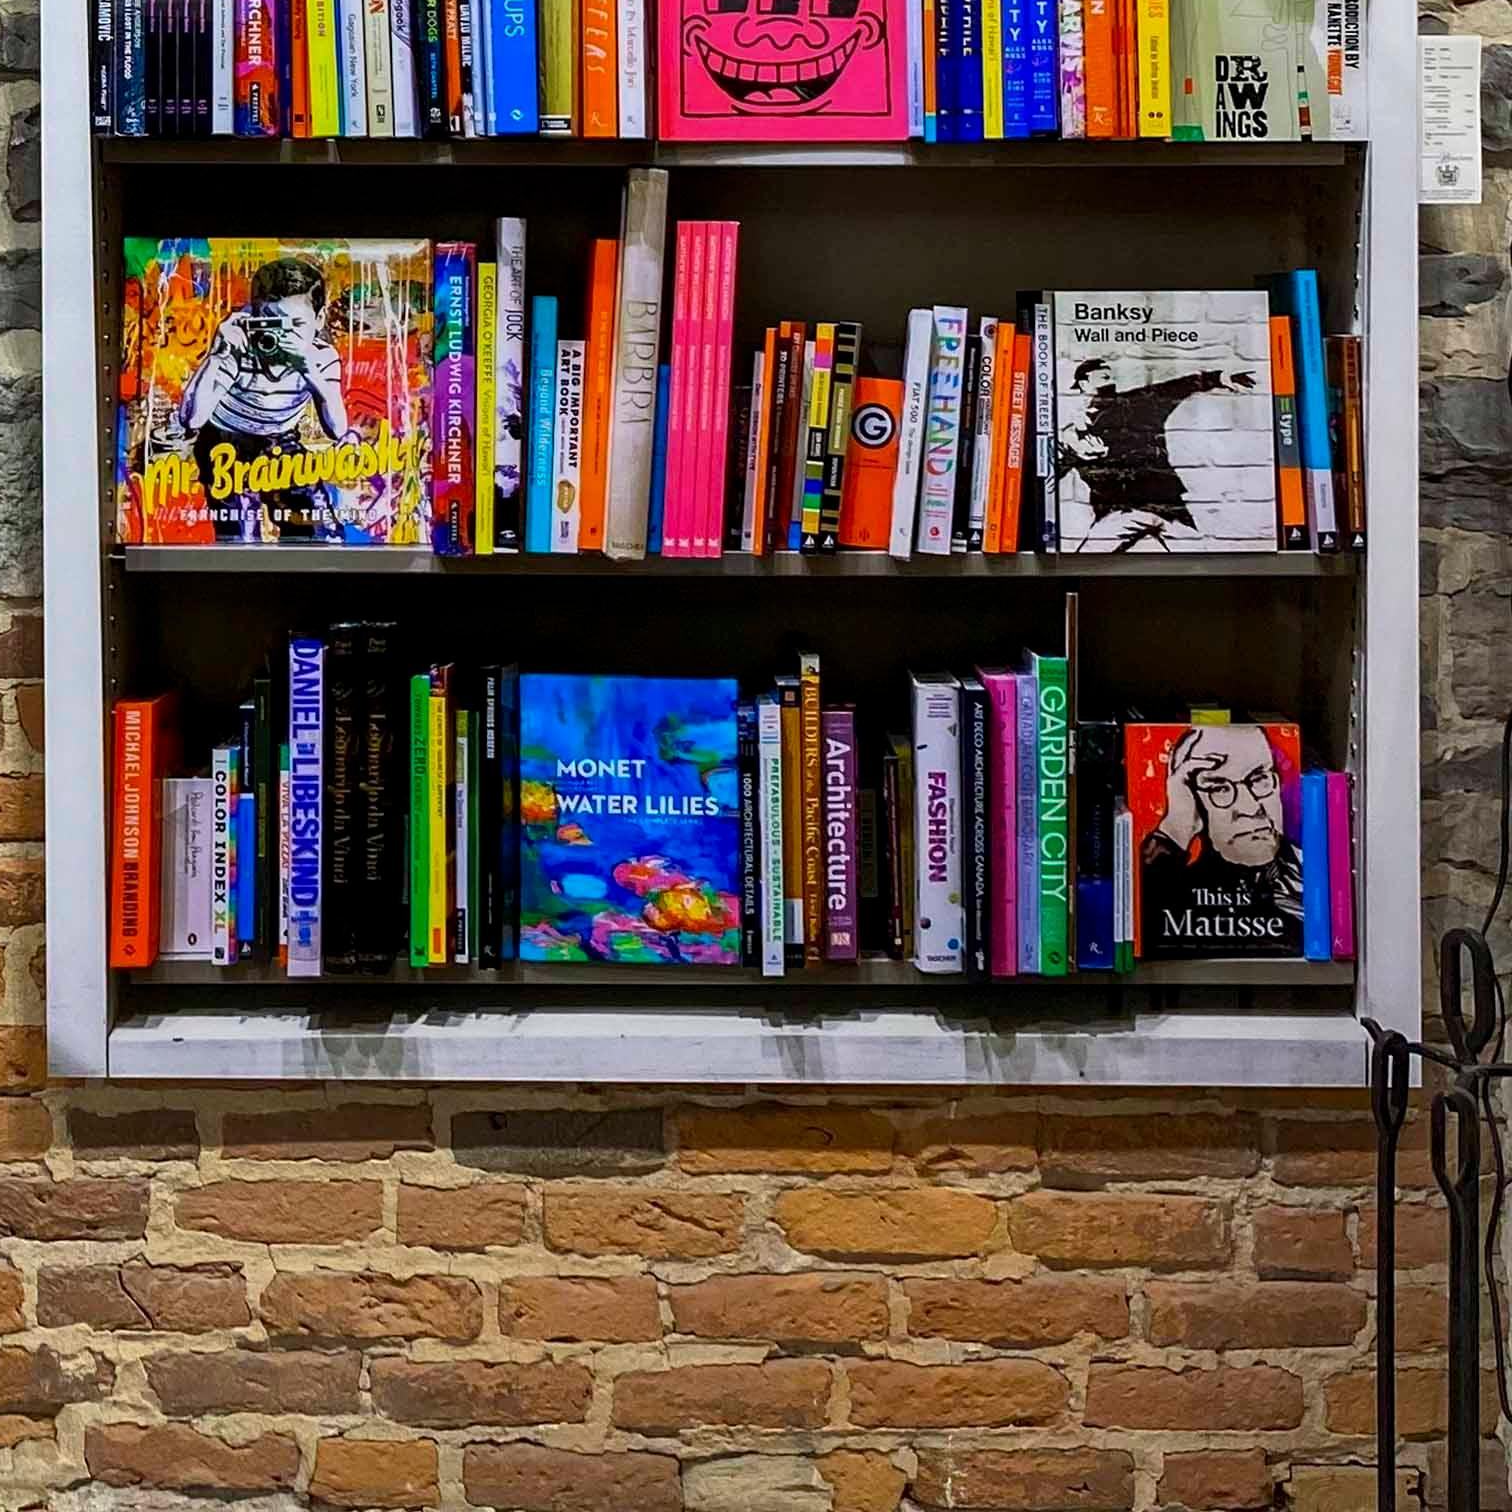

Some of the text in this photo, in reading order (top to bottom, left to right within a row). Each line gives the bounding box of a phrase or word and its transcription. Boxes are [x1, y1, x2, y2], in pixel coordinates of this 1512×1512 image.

[427, 10, 438, 42] DOGS
[1344, 53, 1360, 70] BY
[505, 309, 523, 341] JOCK
[1074, 303, 1153, 324] Banksy
[1074, 328, 1198, 342] Wall and Piece
[446, 275, 462, 483] ERNST LUDWIG KIRCHNER
[927, 317, 963, 476] FREEHAND
[1038, 307, 1049, 428] THE BOOK OF TREES
[568, 348, 581, 469] A BIG IMPORTANT
[1280, 413, 1292, 446] type
[210, 427, 404, 499] Brainwash
[291, 640, 320, 908] DANIEL LIBESKIND
[557, 759, 646, 778] MONET
[1040, 684, 1067, 903] GARDEN CITY
[121, 709, 141, 938] MICHAEL JOHNSON BRANDING
[557, 795, 719, 816] WATER LILIES
[826, 737, 853, 910] Architecture
[928, 771, 947, 883] FASHION
[214, 770, 226, 934] COLOR INDEX XL
[1162, 908, 1284, 937] Matisse
[1193, 888, 1251, 906] This is
